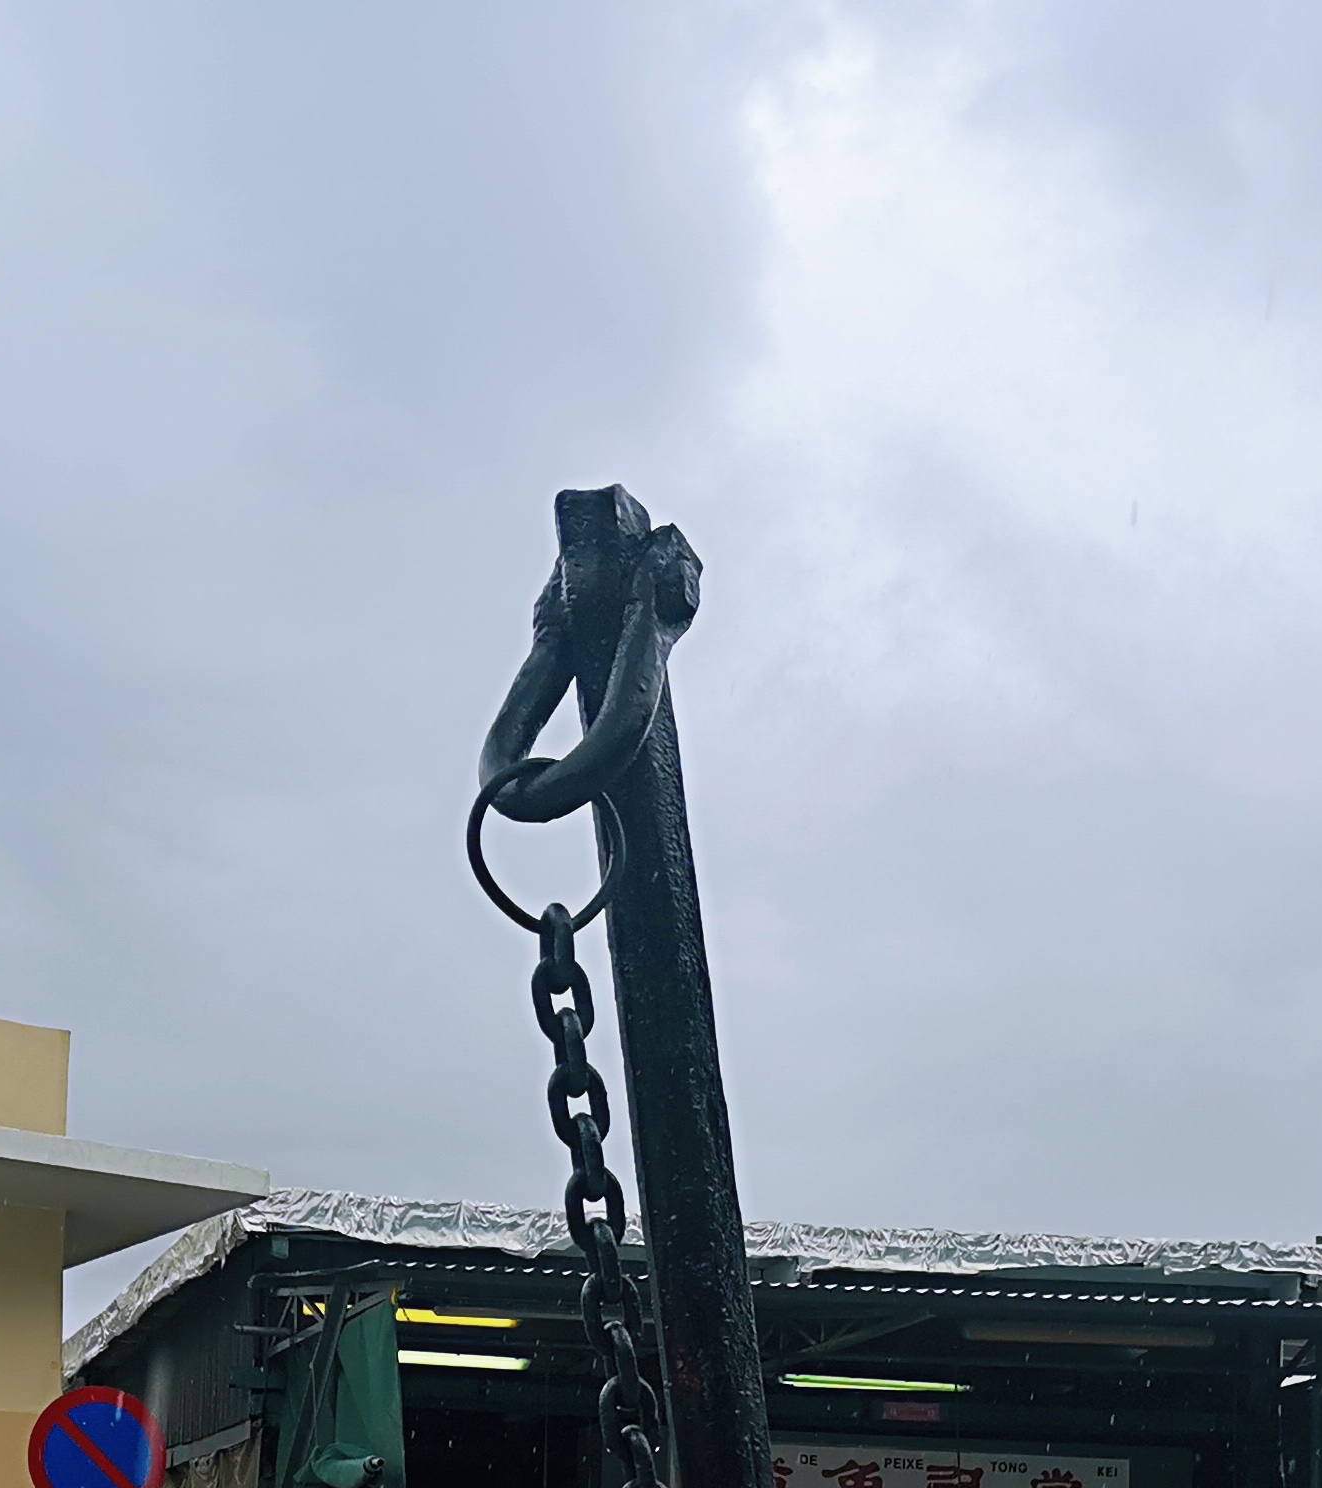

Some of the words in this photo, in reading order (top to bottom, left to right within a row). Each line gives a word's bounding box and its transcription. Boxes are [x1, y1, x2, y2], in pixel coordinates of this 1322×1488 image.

[799, 1453, 818, 1466] DE
[883, 1457, 924, 1470] PEIXE
[990, 1460, 1027, 1475] TONG
[1097, 1465, 1118, 1479] KEI
